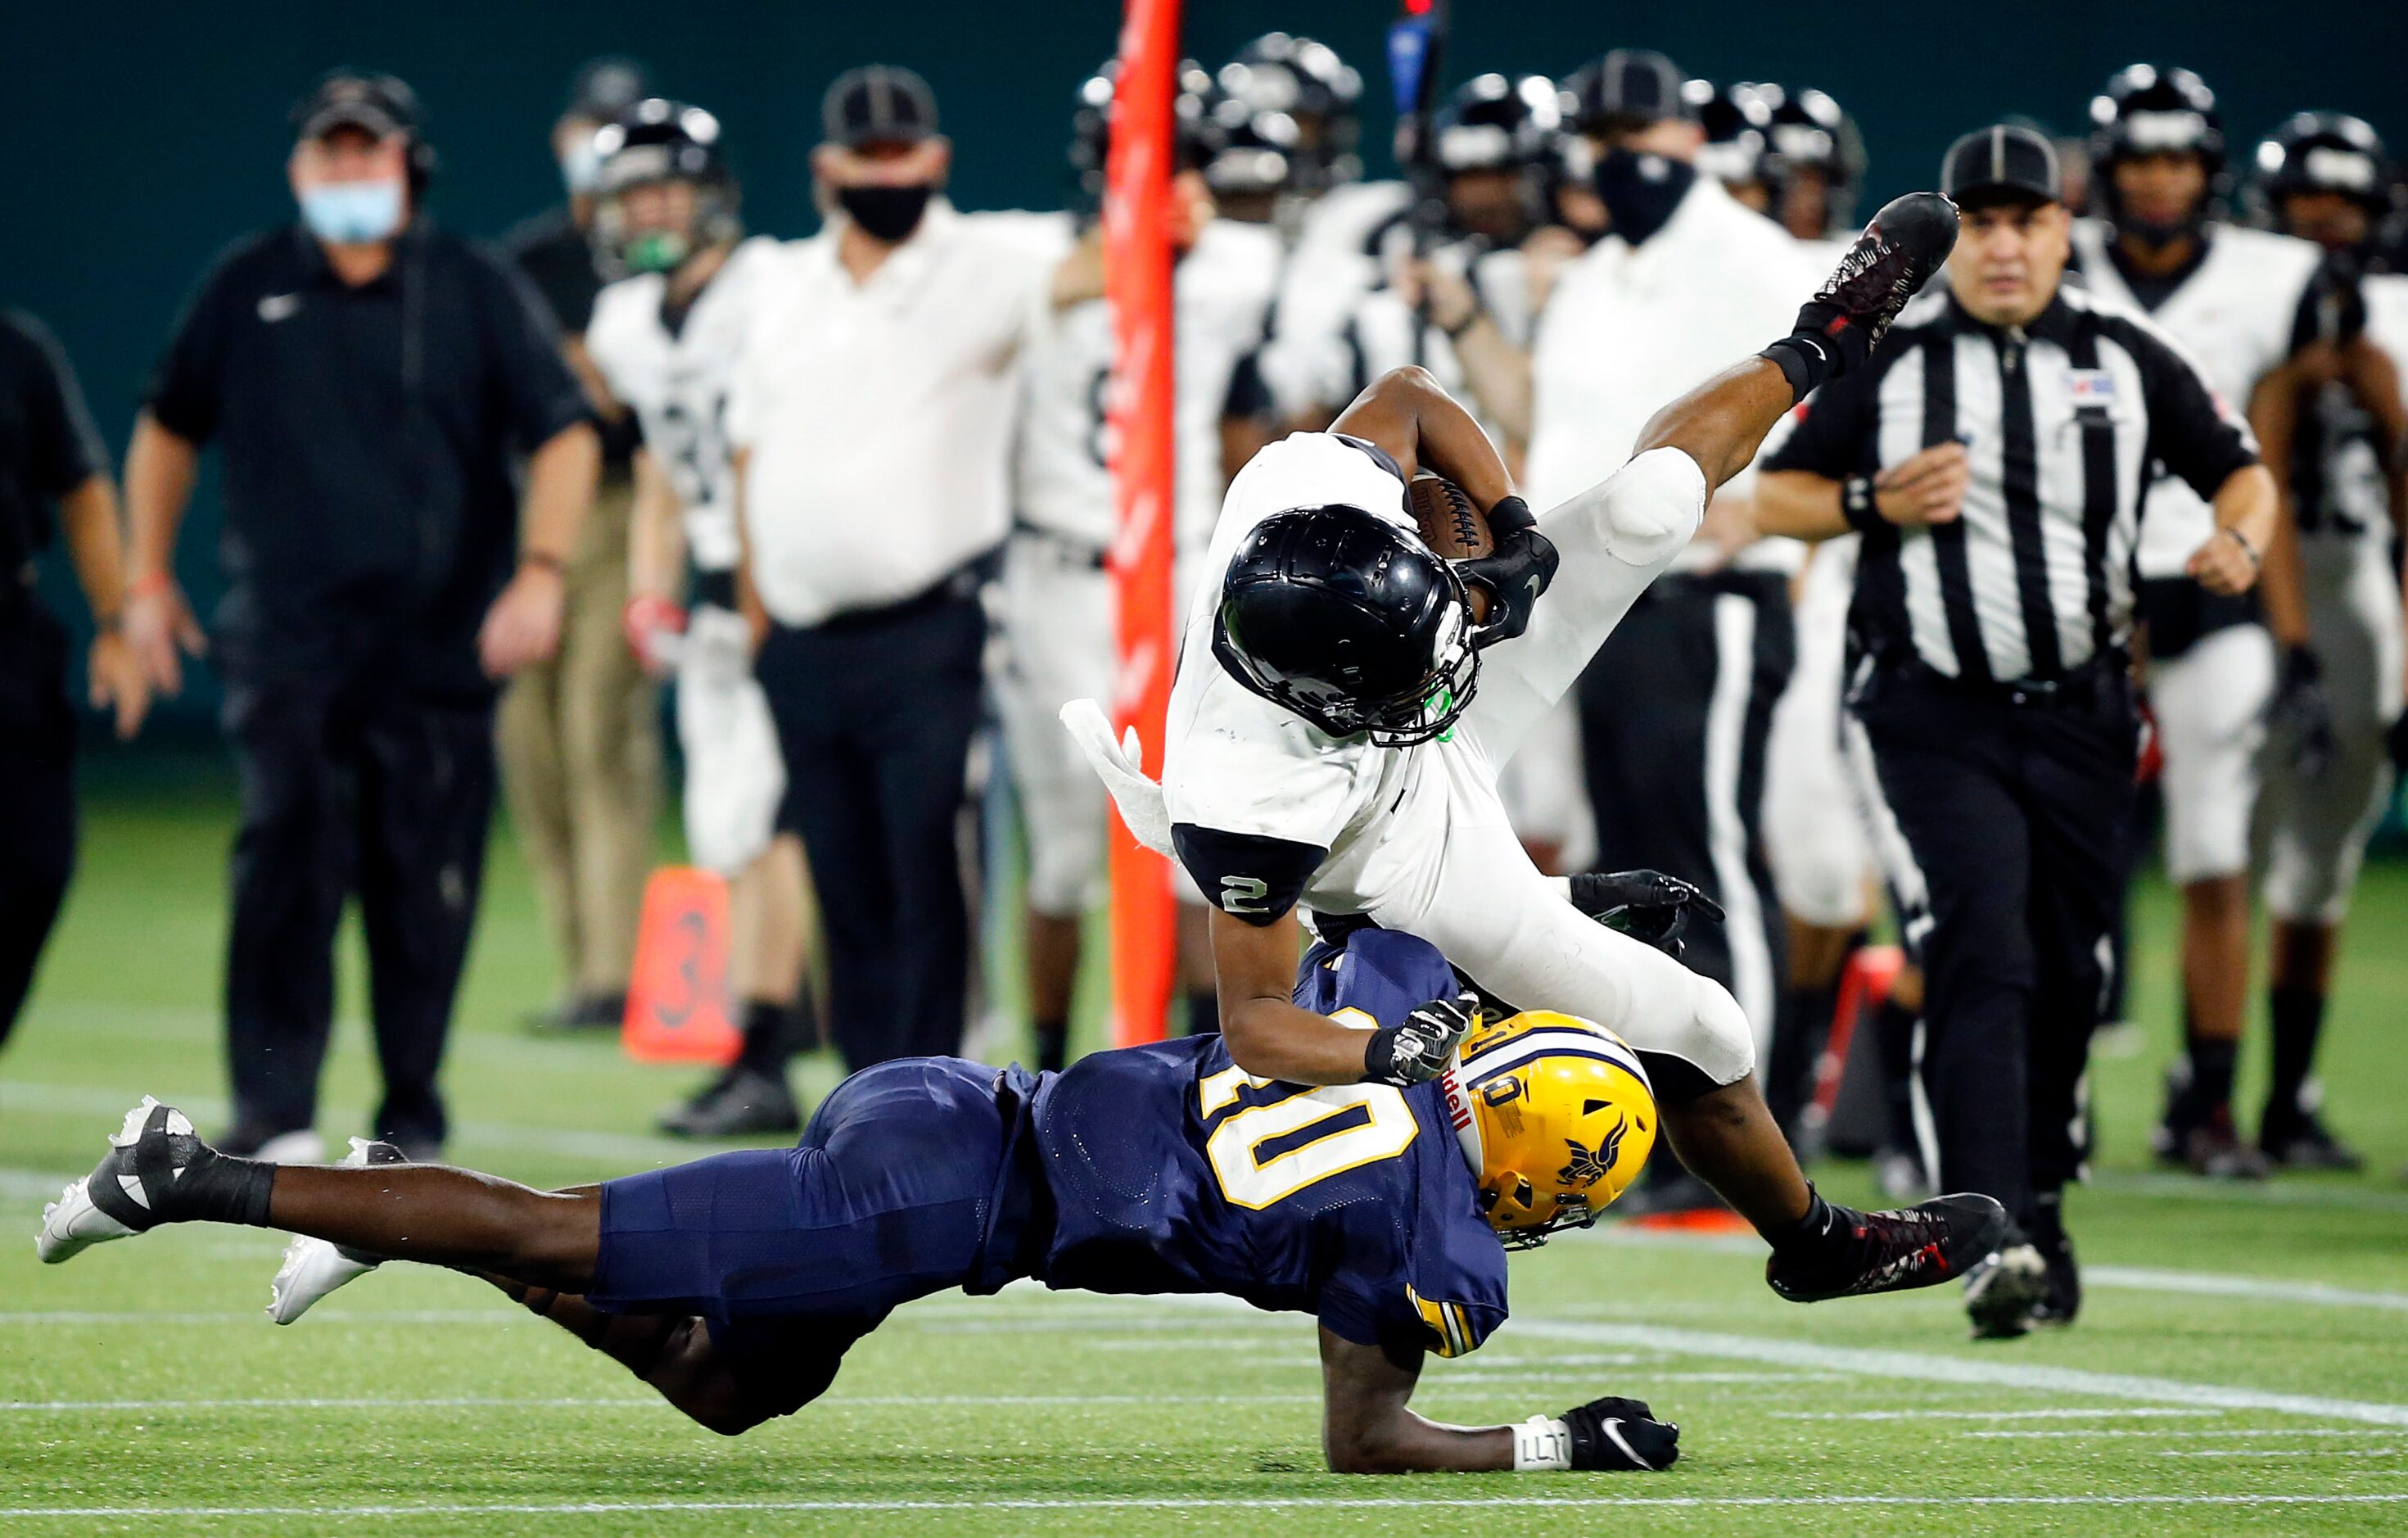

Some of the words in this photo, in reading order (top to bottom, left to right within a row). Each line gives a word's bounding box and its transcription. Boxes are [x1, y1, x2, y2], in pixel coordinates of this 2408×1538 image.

[1220, 875, 1270, 913] 2
[654, 907, 709, 1030] 3
[1440, 1067, 1472, 1133] ddell
[1483, 1075, 1522, 1108] 0
